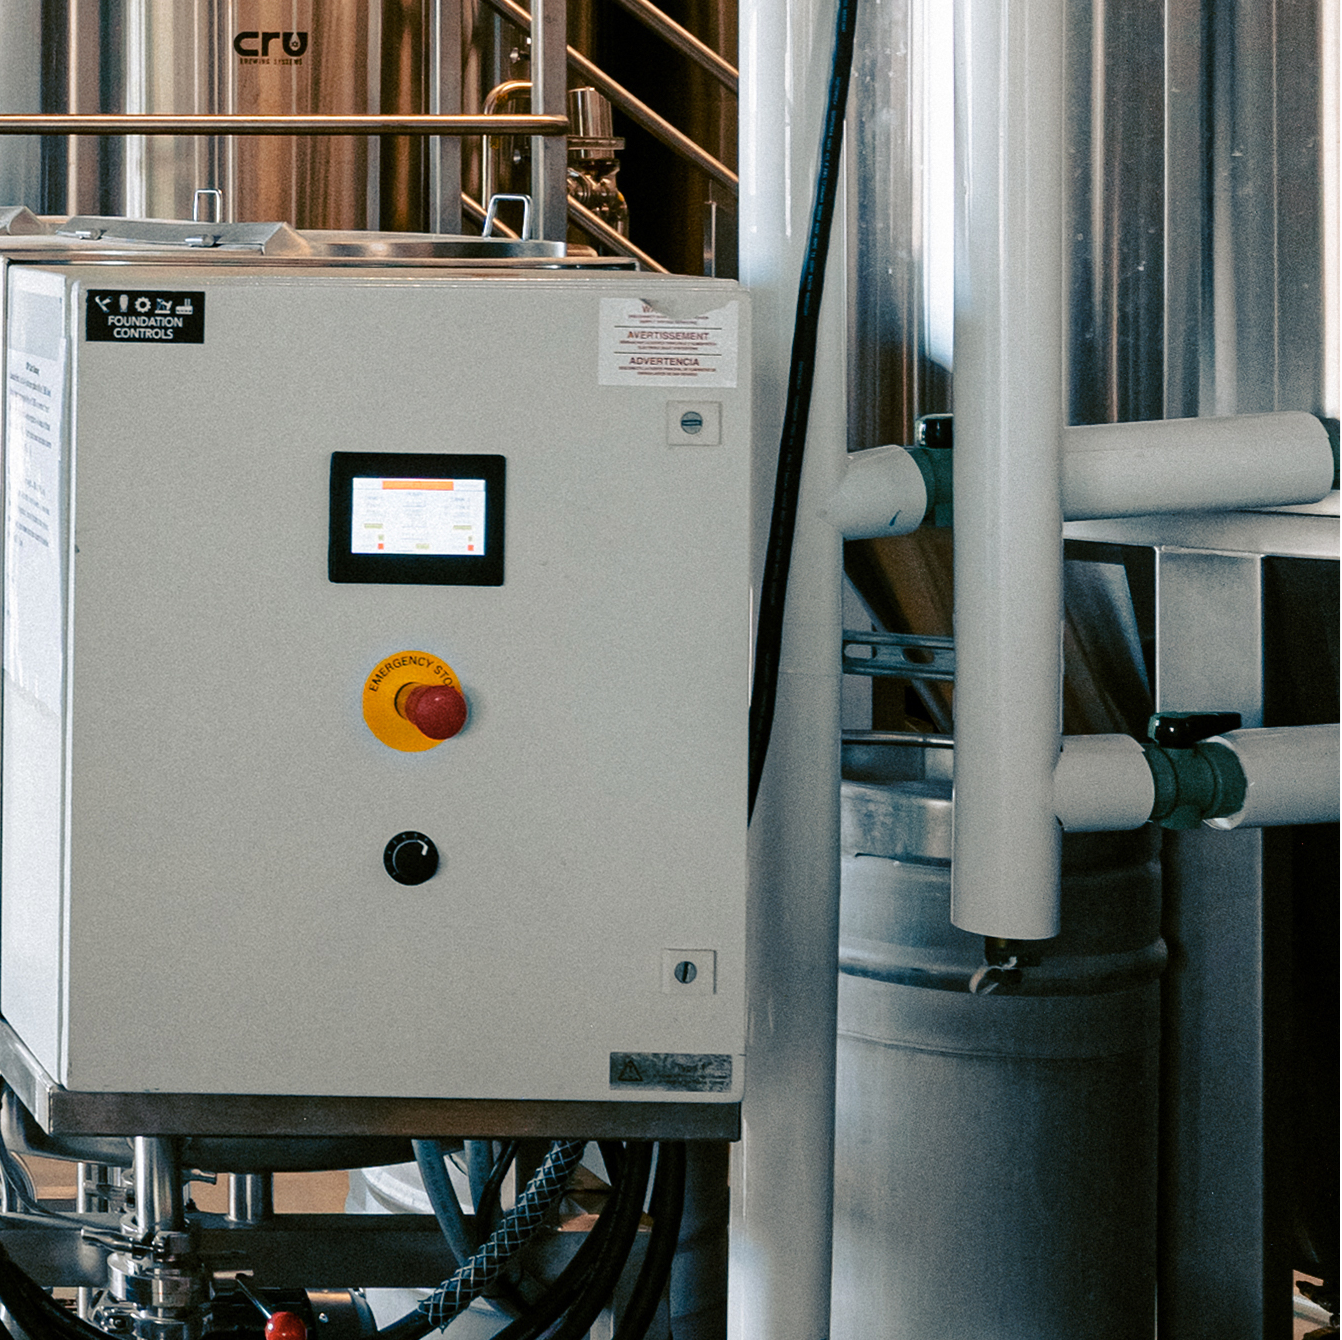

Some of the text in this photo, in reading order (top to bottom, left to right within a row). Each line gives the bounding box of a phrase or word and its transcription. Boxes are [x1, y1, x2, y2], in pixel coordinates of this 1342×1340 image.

[107, 315, 184, 328] FOUNDATION
[113, 327, 174, 340] CONTROLS
[627, 331, 710, 341] AVERTISSEMENT
[629, 356, 700, 367] ADVERTENCIA
[369, 656, 455, 693] EMERGENCY STO
